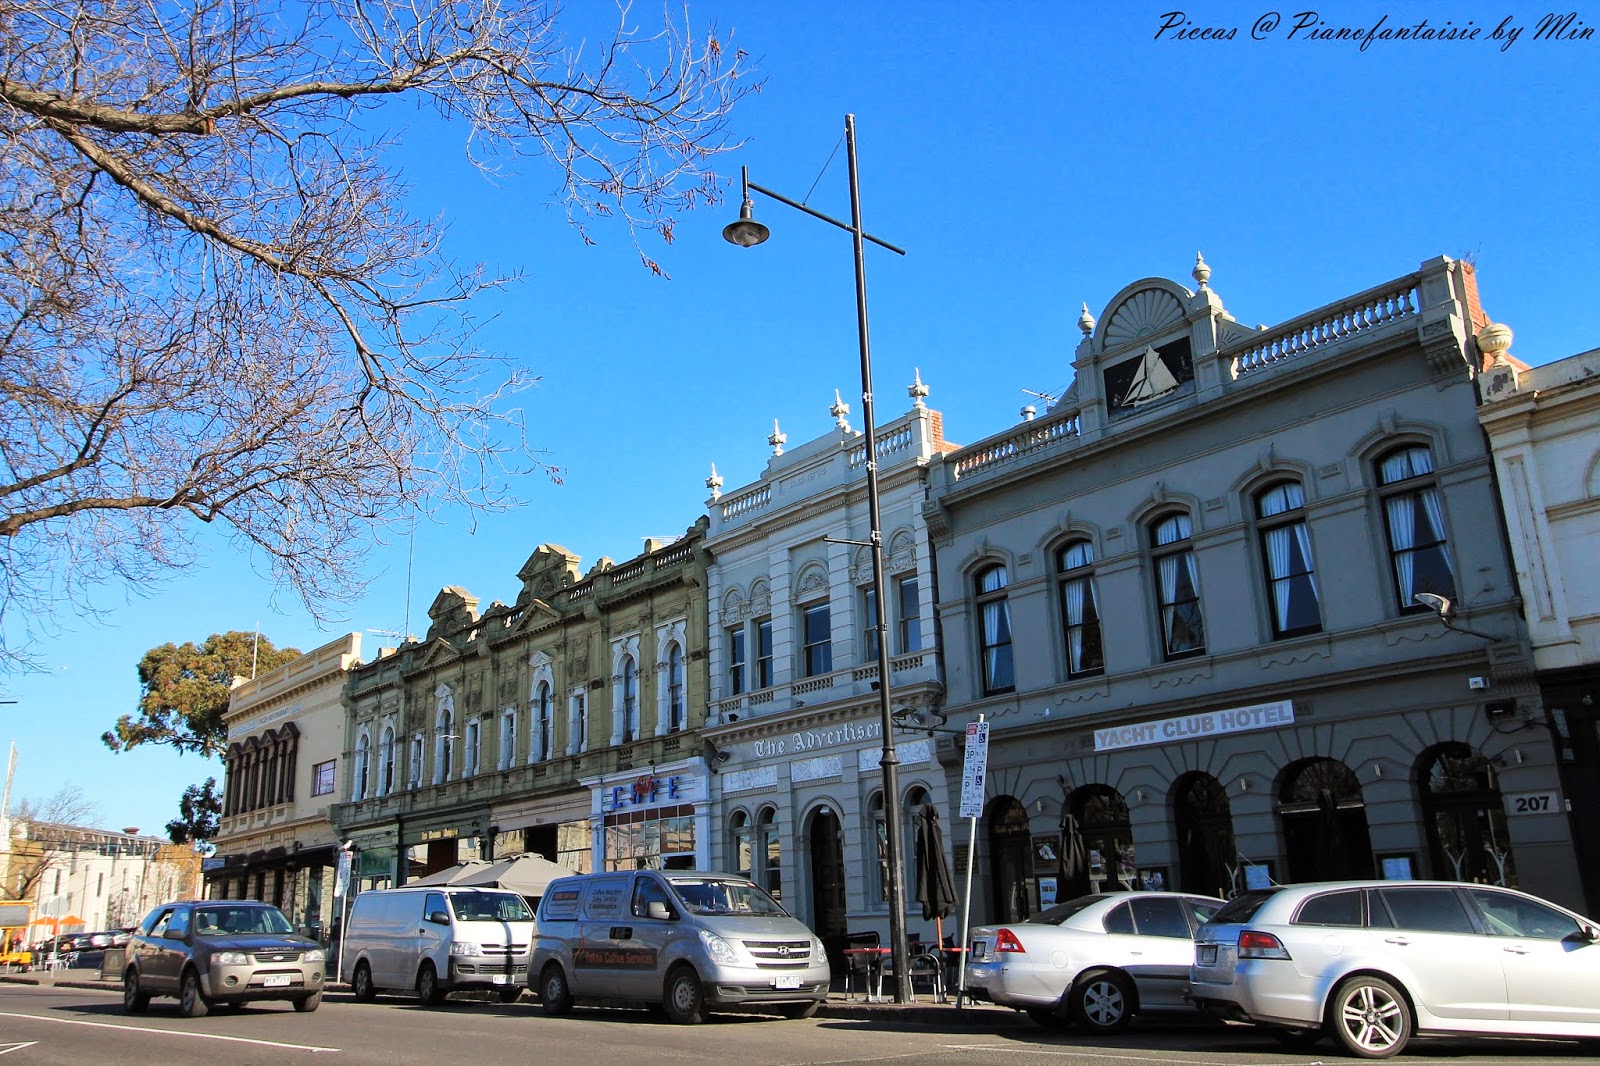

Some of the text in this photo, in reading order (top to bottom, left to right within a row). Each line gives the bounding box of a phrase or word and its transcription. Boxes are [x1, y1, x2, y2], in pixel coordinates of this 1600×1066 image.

[1096, 704, 1292, 748] YACHT CLUB HOTEL
[754, 722, 882, 758] The Advertiser
[966, 750, 975, 760] 3P
[1515, 795, 1550, 813] 207
[604, 951, 625, 964] Coffee
[625, 951, 654, 964] Services
